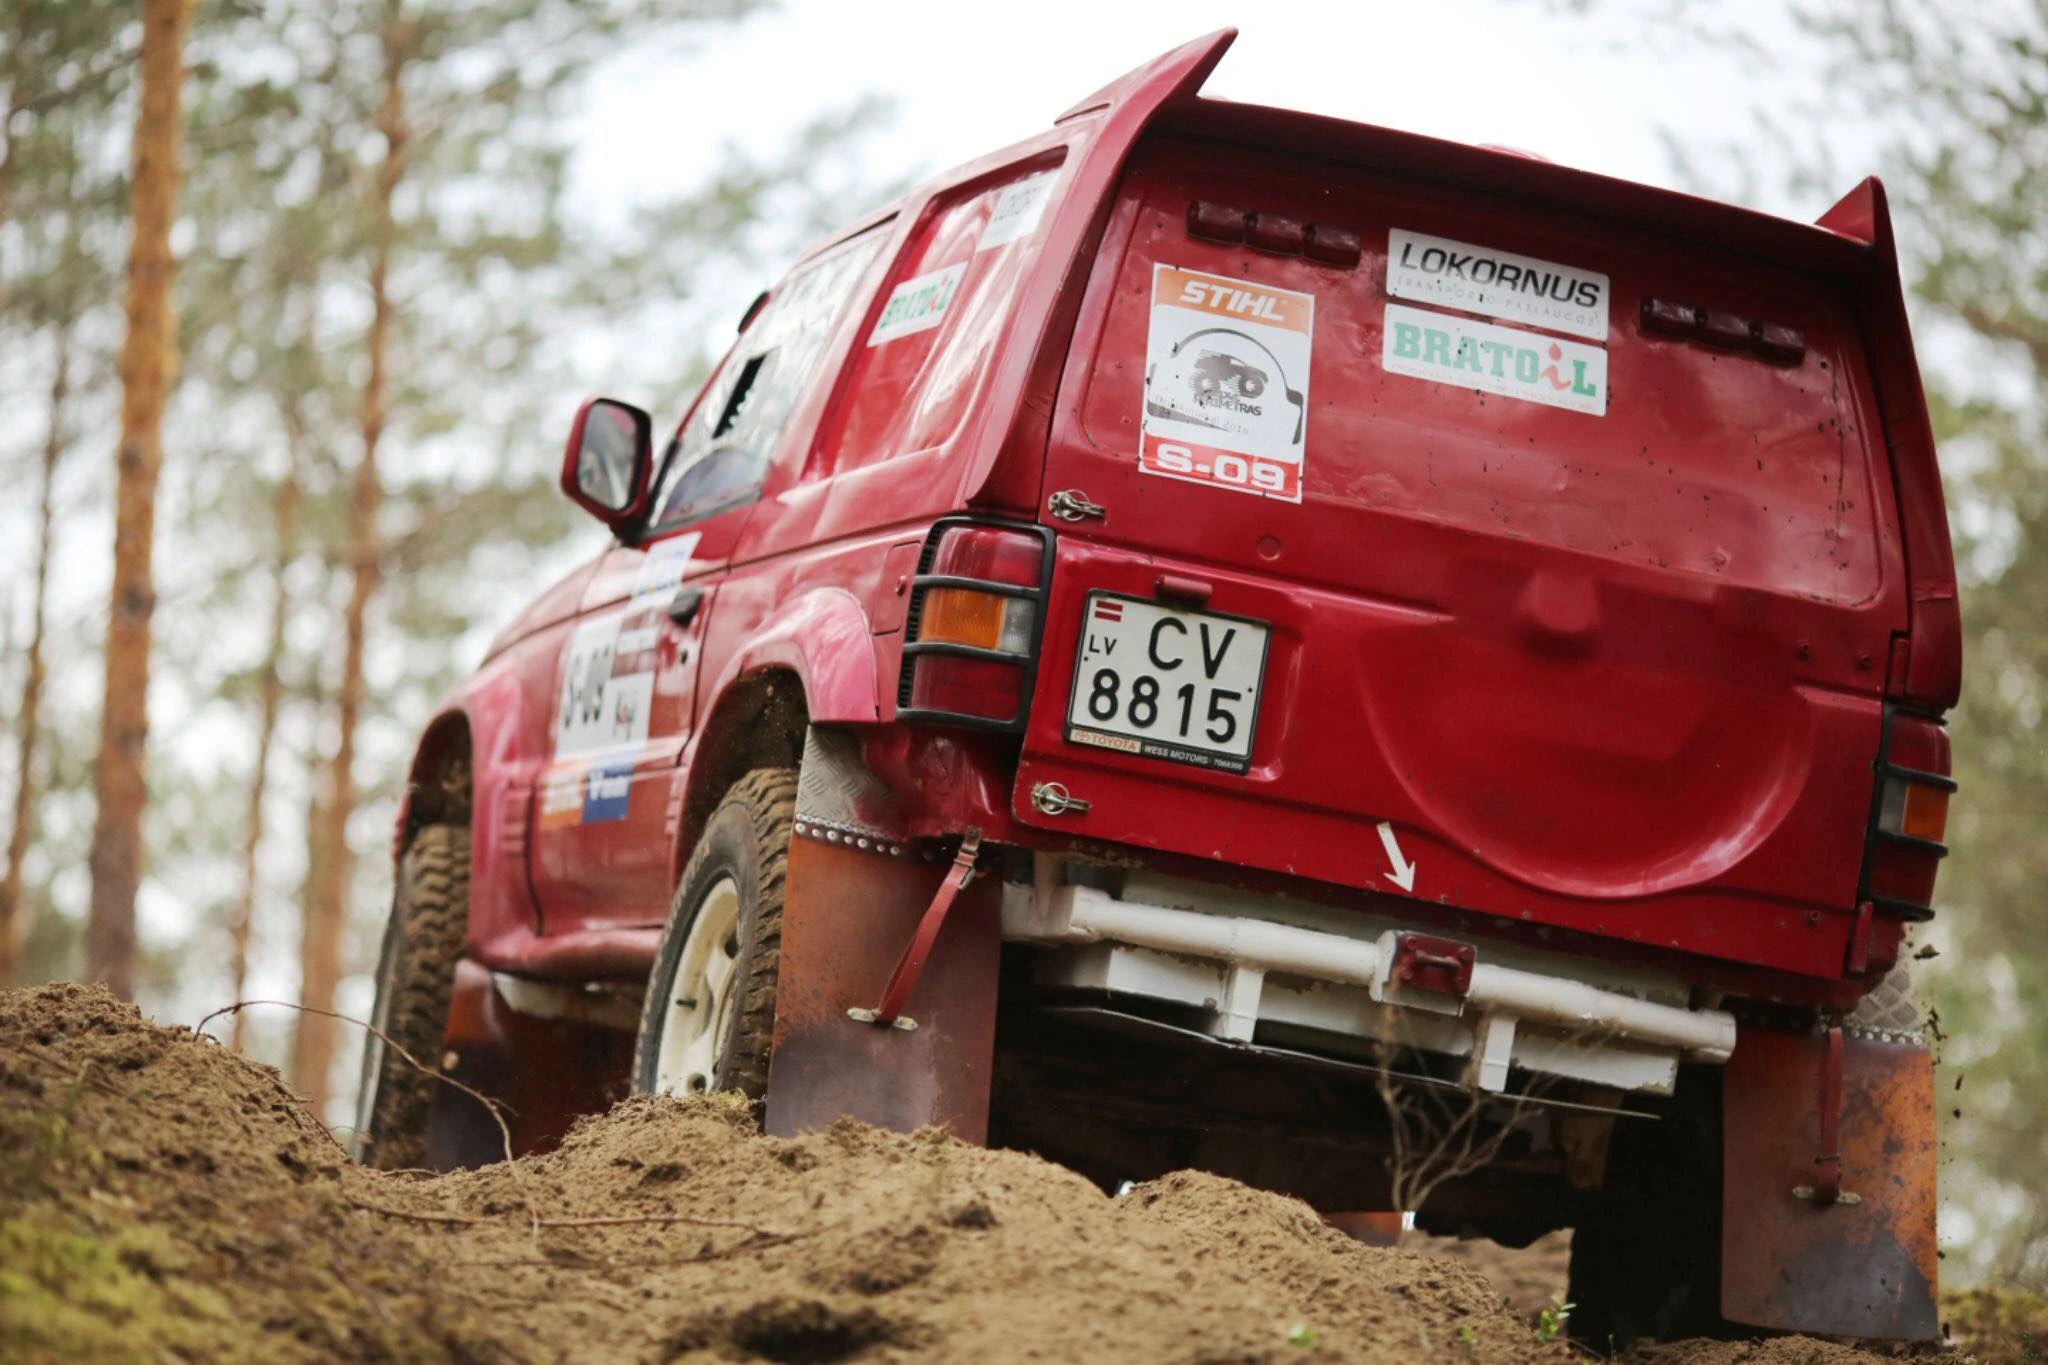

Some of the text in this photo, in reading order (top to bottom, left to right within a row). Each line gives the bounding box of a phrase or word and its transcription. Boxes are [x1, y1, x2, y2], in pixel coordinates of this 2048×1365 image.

[1179, 280, 1284, 322] STIHL
[1400, 243, 1601, 308] LOKORNUS
[1156, 444, 1285, 491] S-09
[1089, 616, 1236, 680] LV CV
[1088, 668, 1242, 743] 8815
[1093, 735, 1137, 750] TOYOTA
[1144, 745, 1169, 757] WESS
[1170, 750, 1209, 765] MOTORS
